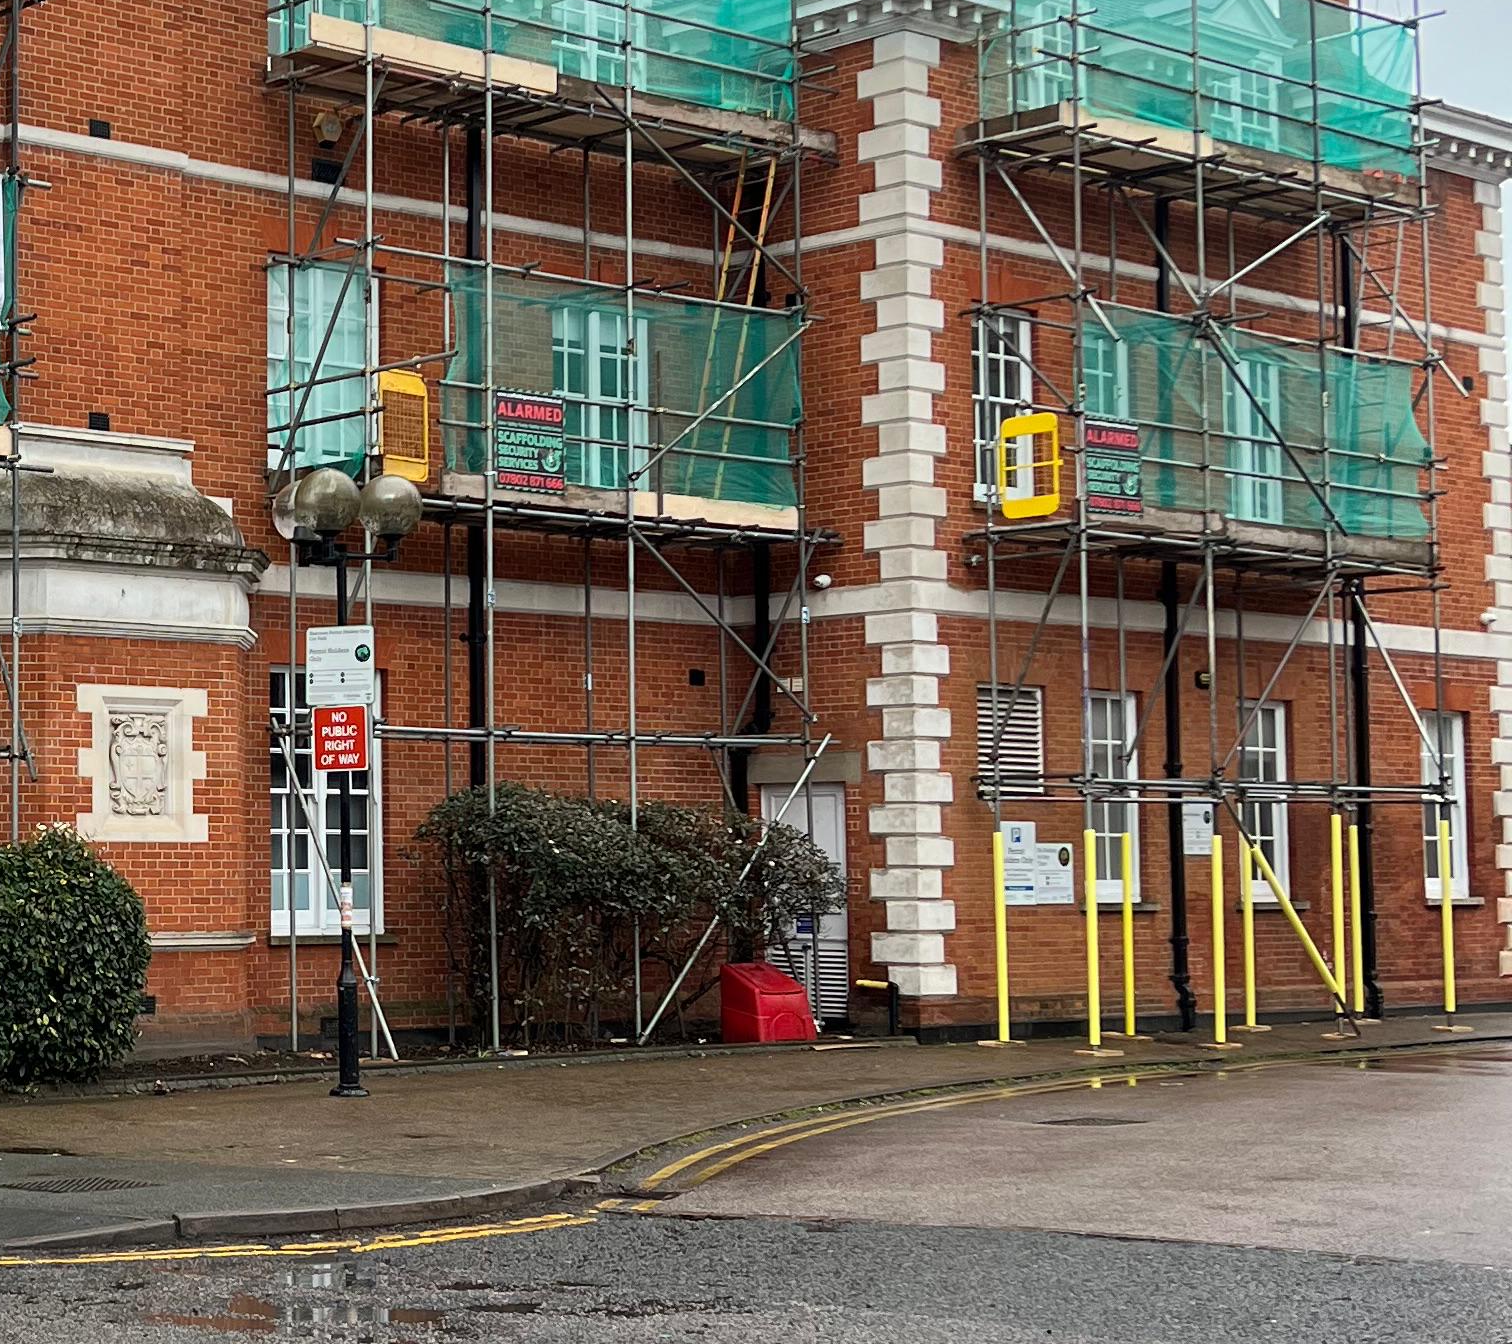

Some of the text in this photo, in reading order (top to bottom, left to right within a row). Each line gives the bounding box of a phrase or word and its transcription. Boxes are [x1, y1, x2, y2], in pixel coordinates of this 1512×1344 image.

[497, 401, 563, 423] ALARMED
[497, 430, 563, 449] SCAFFOLDING
[498, 443, 539, 459] SECURITY
[331, 711, 348, 723] NO
[321, 725, 358, 737] PUBLIC
[324, 739, 356, 752] RIGHT
[320, 753, 360, 766] OF WAY
